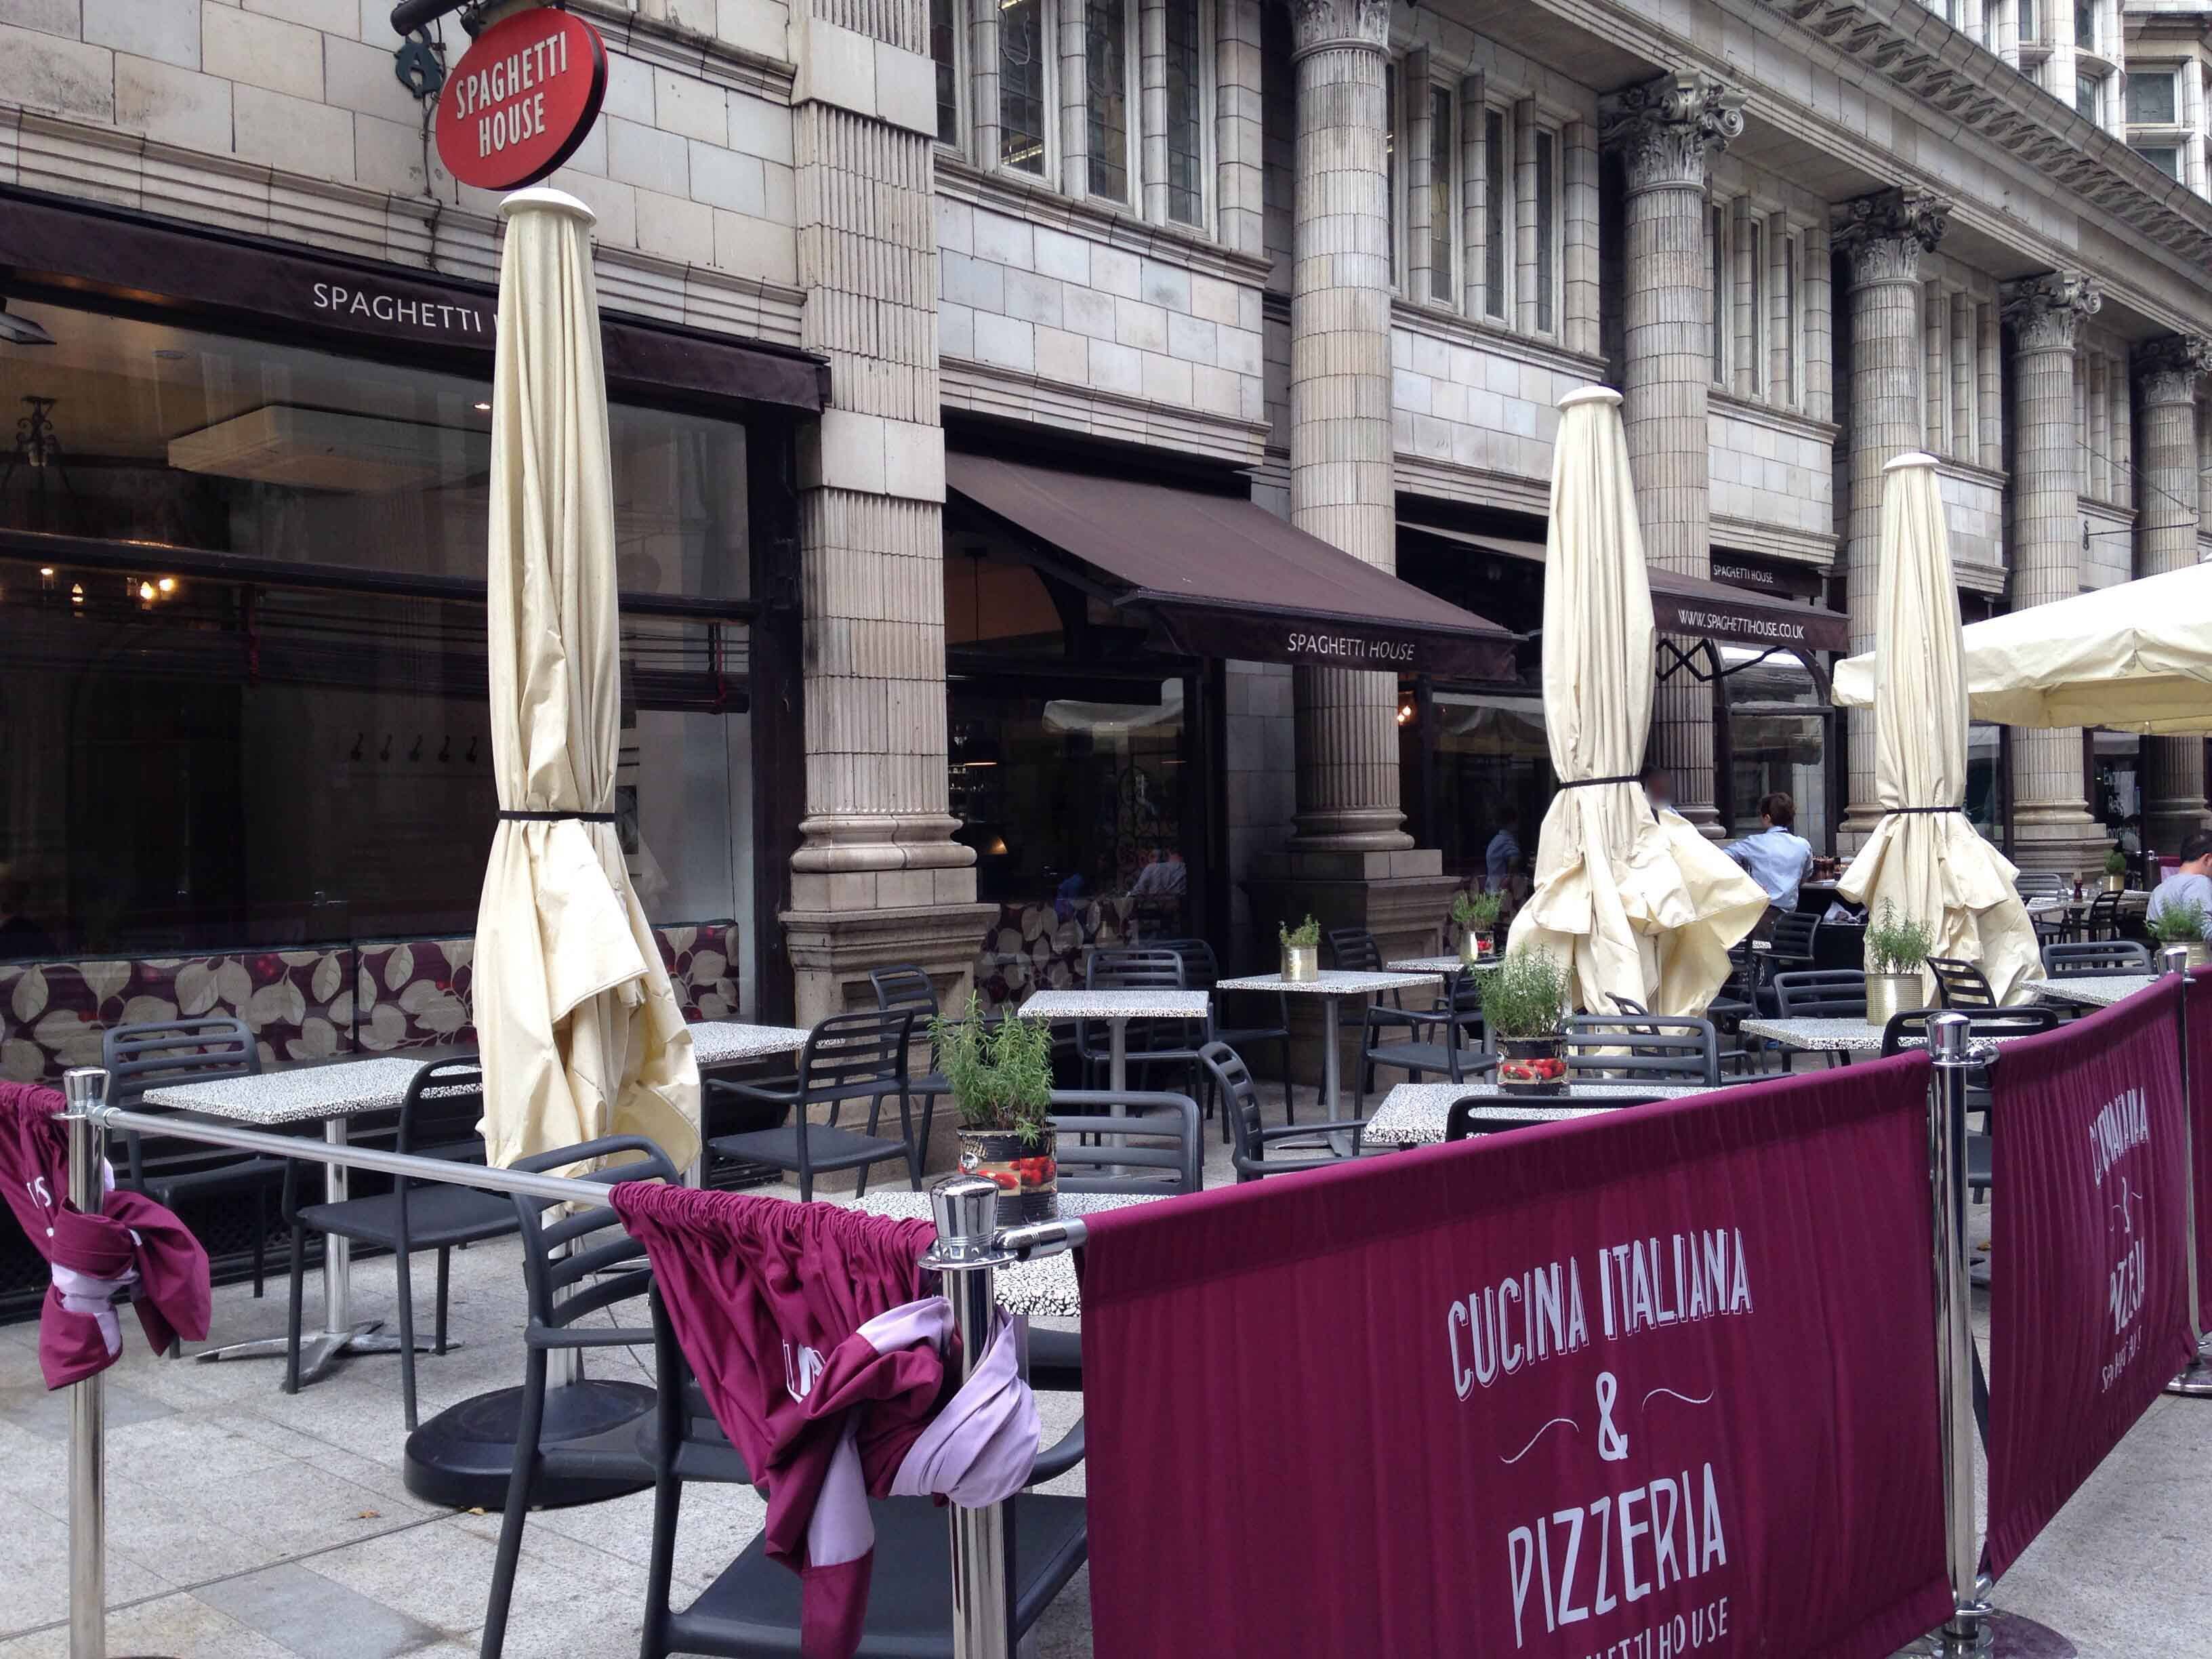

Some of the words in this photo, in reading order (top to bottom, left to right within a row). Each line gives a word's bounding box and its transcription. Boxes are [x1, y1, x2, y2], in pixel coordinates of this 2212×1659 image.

[455, 30, 569, 120] SPAGHETTI
[478, 92, 546, 158] HOUSE
[313, 283, 482, 333] SPAGHETTI
[1713, 564, 1750, 579] SPAGHETTI
[1751, 571, 1774, 583] HOUSE
[1287, 633, 1366, 657] SPAGHETTI
[1369, 641, 1416, 661] HOUSE
[1448, 1256, 1590, 1402] CUCINA
[1599, 1227, 1754, 1341] ITALIANA
[1595, 1371, 1629, 1461] &
[1507, 1462, 1727, 1649] PIZZERIA
[1659, 1596, 1728, 1659] HOUSE
